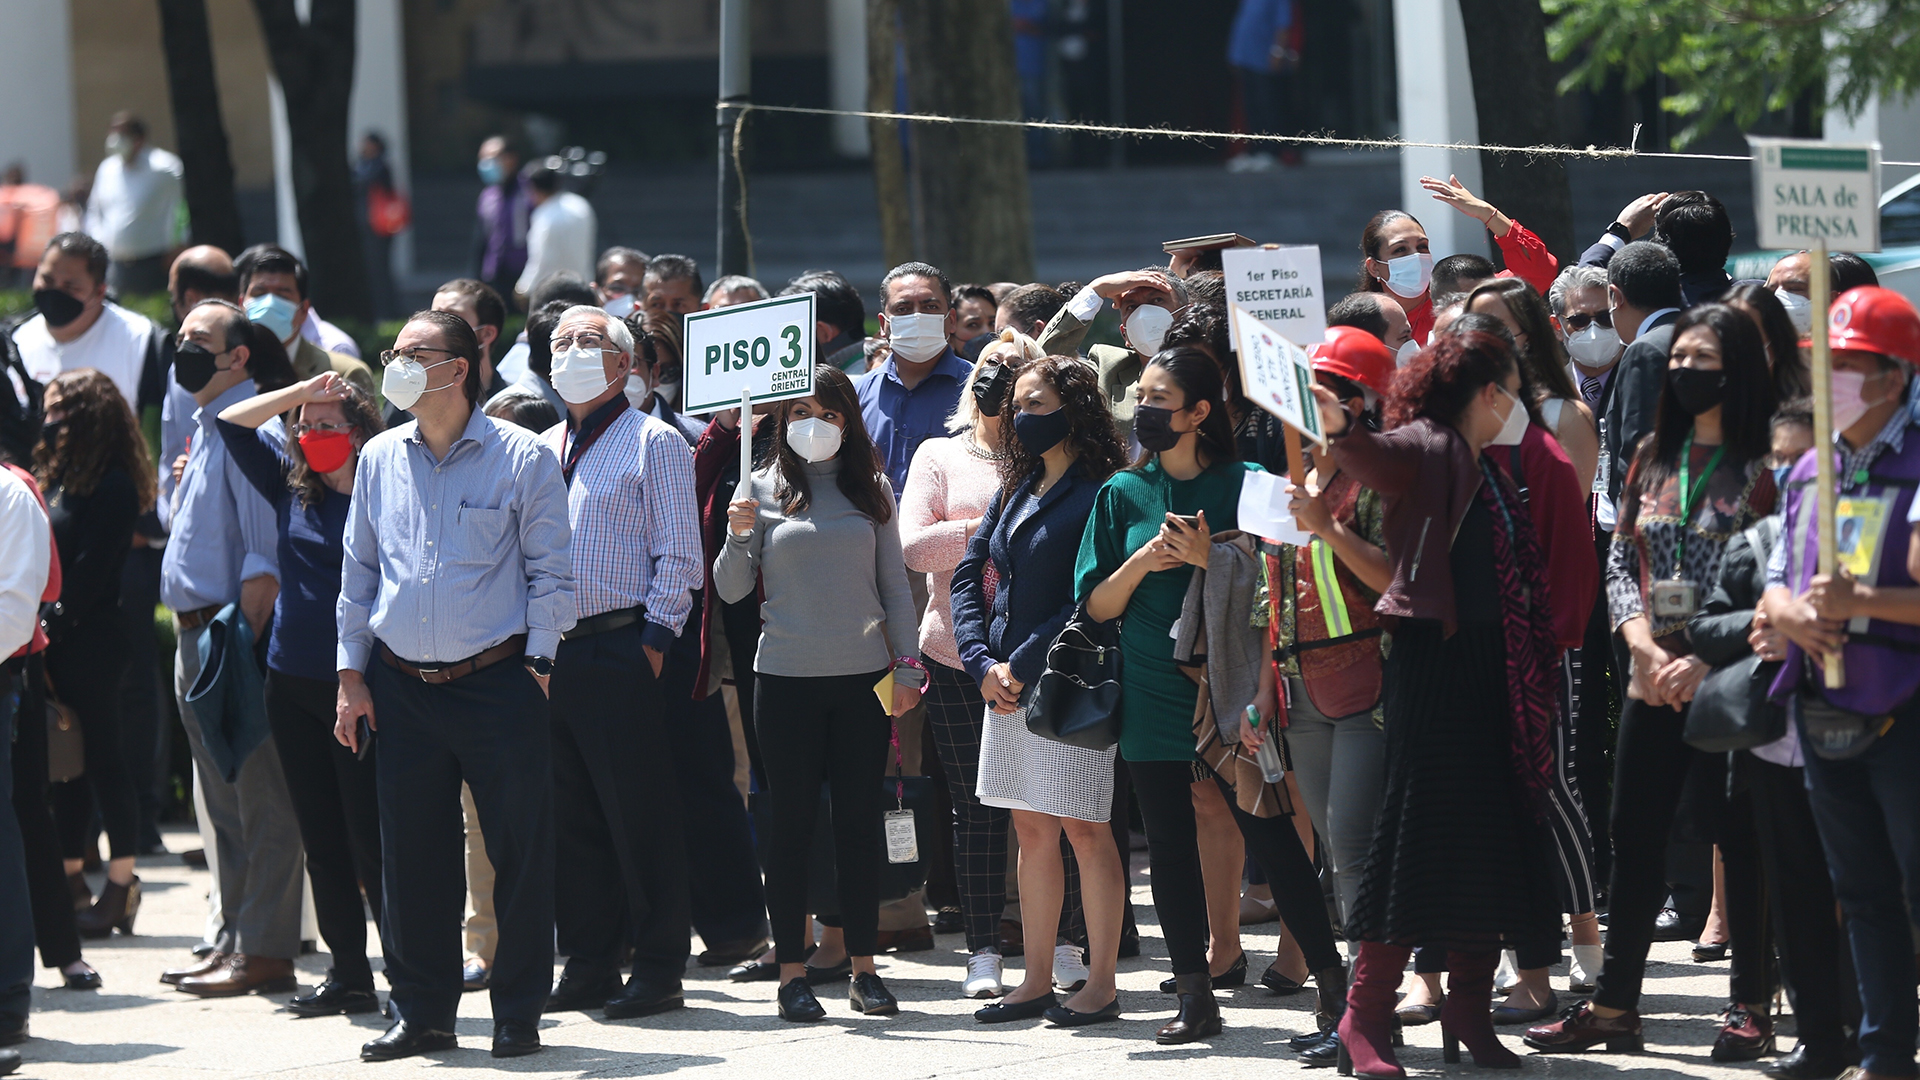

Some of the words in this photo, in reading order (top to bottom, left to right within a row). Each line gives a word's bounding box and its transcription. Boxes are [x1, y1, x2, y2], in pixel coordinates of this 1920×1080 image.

[1775, 184, 1826, 207] SALA
[1833, 184, 1858, 209] de
[1777, 215, 1858, 238] PRENSA
[1247, 270, 1265, 281] 1er
[1271, 268, 1298, 280] Piso
[1236, 285, 1314, 302] SECRETARÍA
[705, 336, 771, 376] PISO
[779, 325, 802, 369] 3
[1251, 334, 1267, 387] ORIENTE
[771, 368, 808, 382] CENTRAL
[1266, 355, 1277, 381] ALA
[1276, 342, 1296, 414] MEZZANINE
[771, 378, 806, 392] ORIENTE
